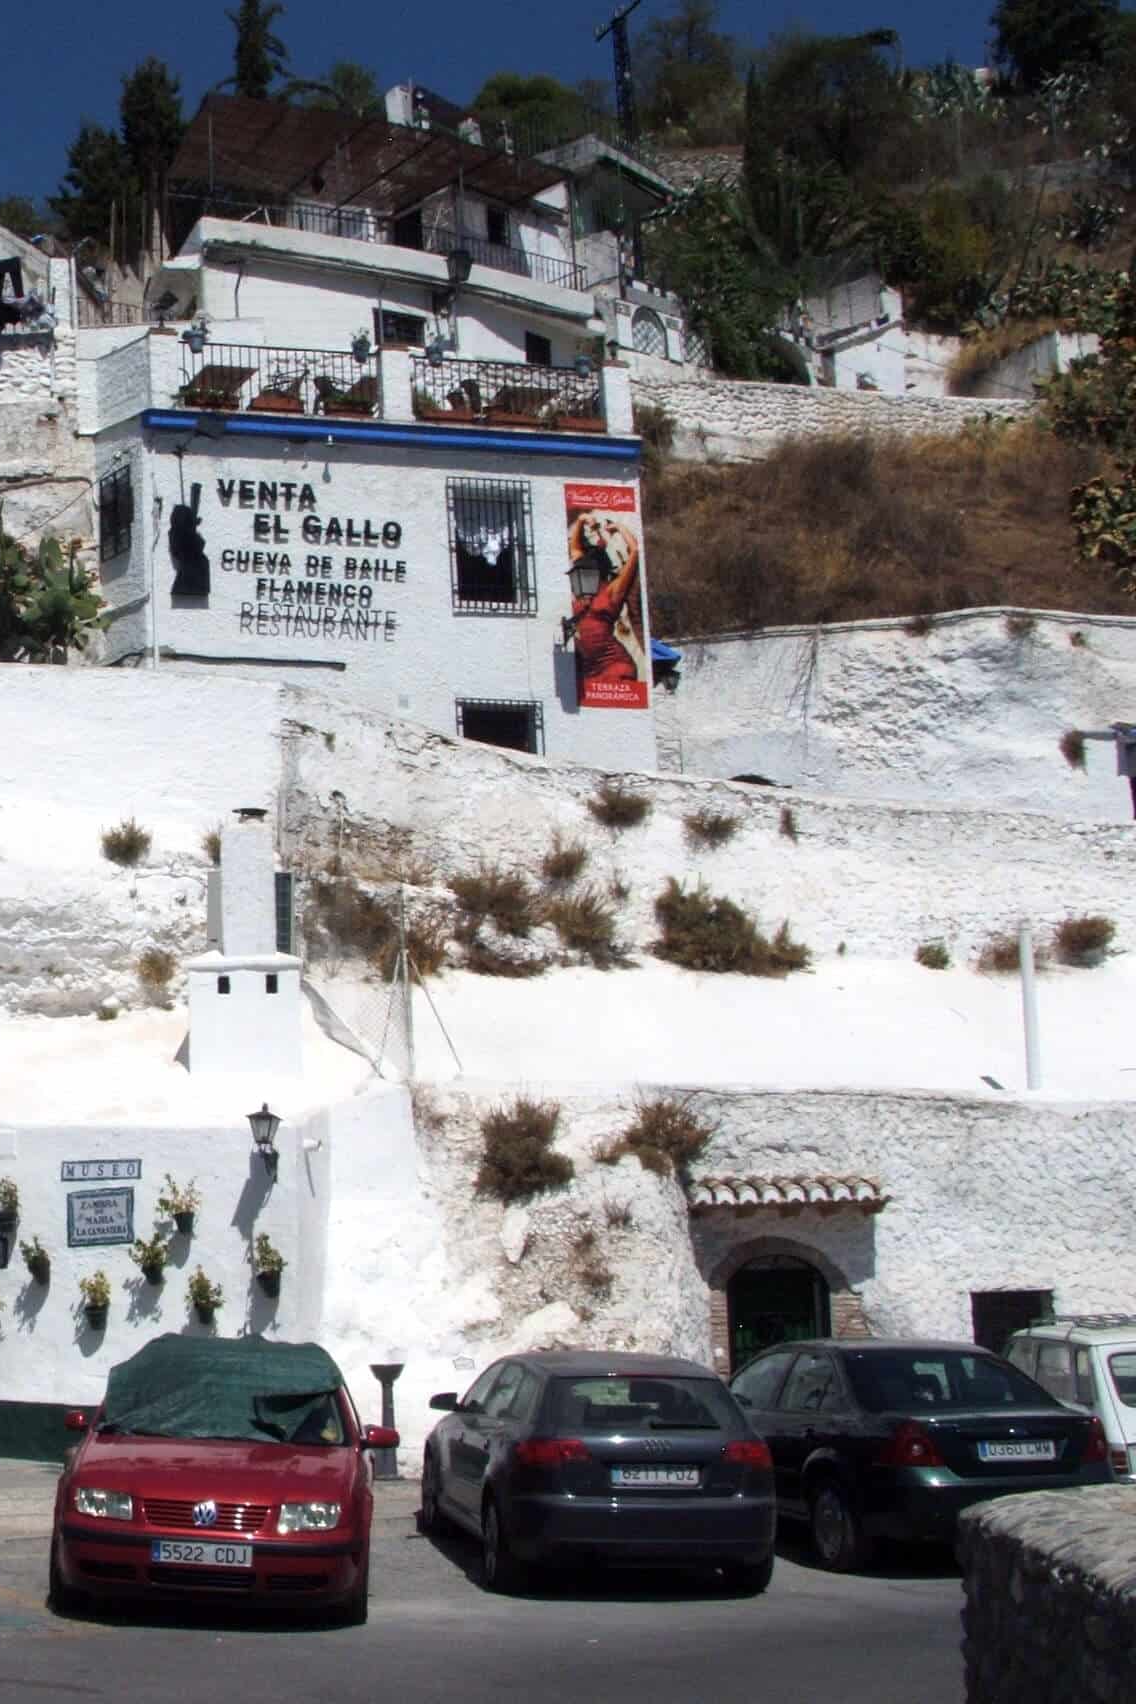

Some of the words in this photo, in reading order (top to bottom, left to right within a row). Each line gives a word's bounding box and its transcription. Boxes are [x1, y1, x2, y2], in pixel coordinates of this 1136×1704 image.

[217, 478, 318, 505] VENTA
[253, 513, 290, 537] EL
[302, 514, 403, 543] GALLO
[221, 549, 292, 570] CUEVA
[306, 554, 333, 572] DE
[344, 556, 407, 576] BAILE
[256, 577, 373, 603] FLAMENCO
[240, 601, 398, 631] RESTAURANTE
[66, 1163, 136, 1177] MUSEO
[162, 1543, 204, 1562] 5522
[215, 1547, 247, 1564] CDJ
